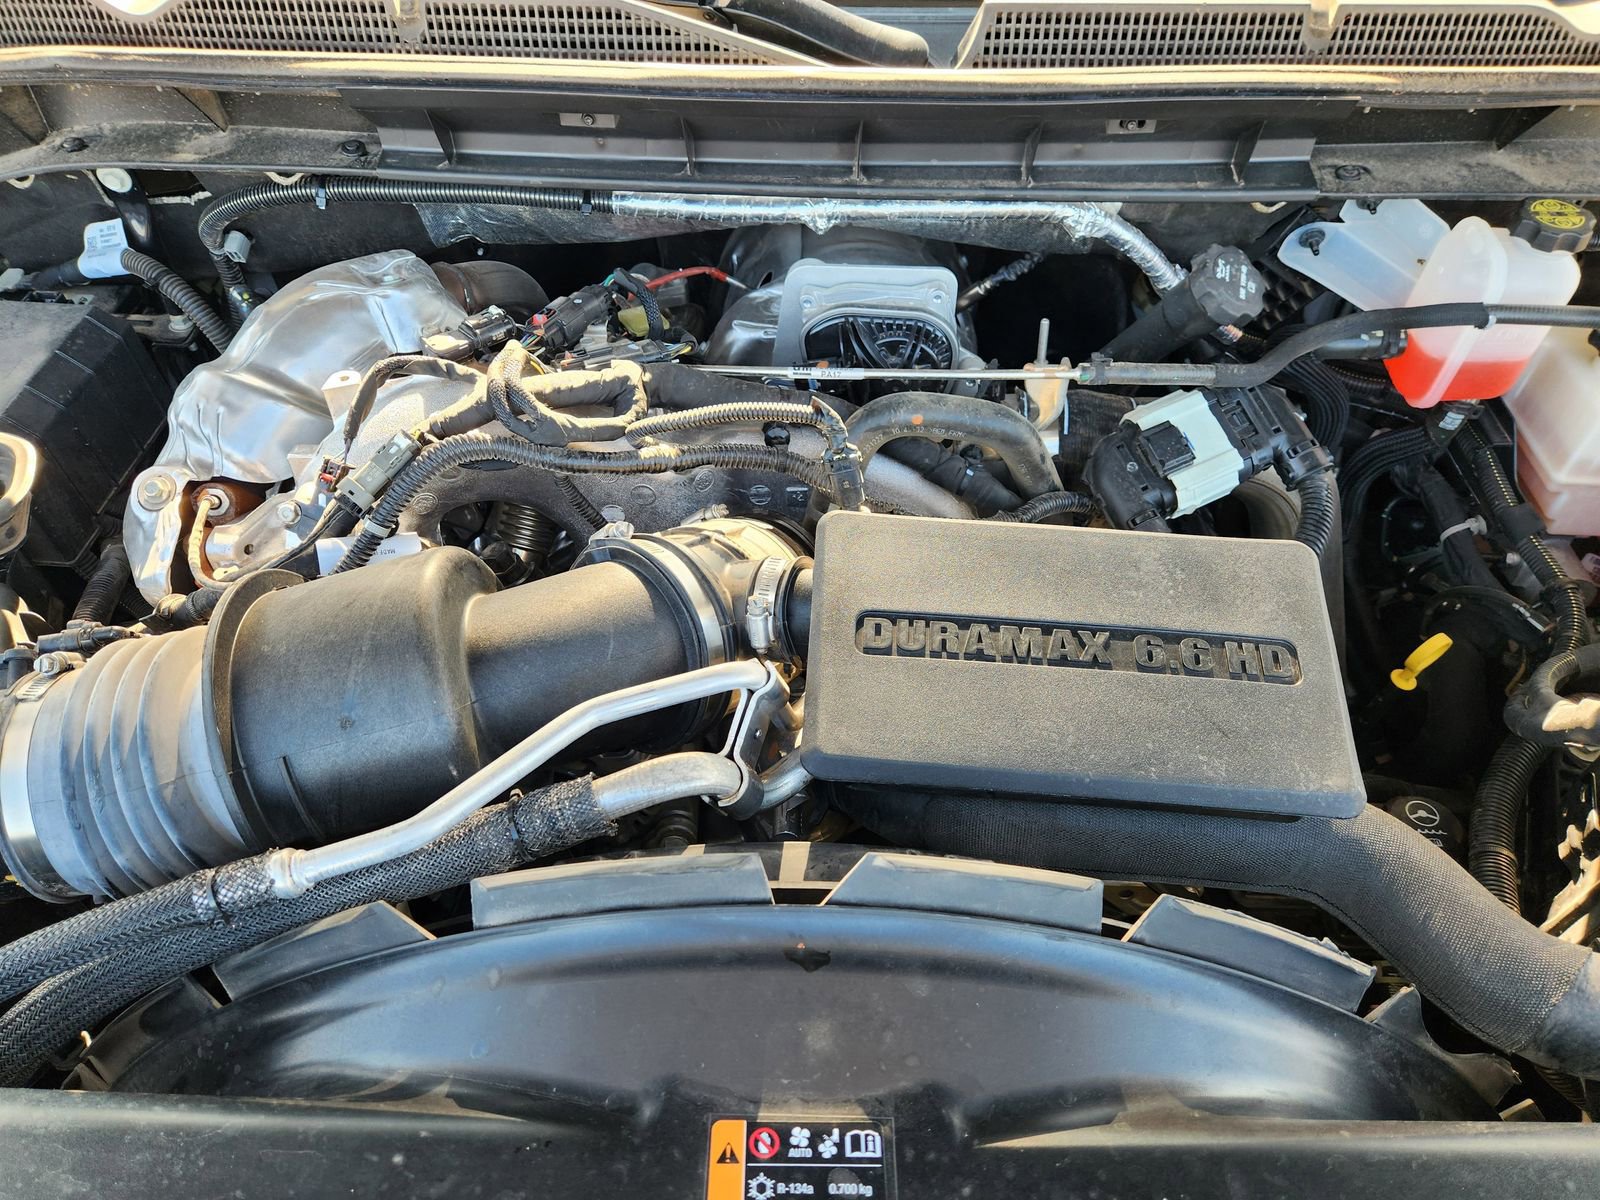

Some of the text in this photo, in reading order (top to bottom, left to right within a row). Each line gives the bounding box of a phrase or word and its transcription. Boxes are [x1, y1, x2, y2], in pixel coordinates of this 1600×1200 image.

[863, 617, 1296, 680] DURAMAX 6.6 HD
[788, 1147, 813, 1158] AUTO
[777, 1183, 873, 1197] R-134a 0.700 kg
